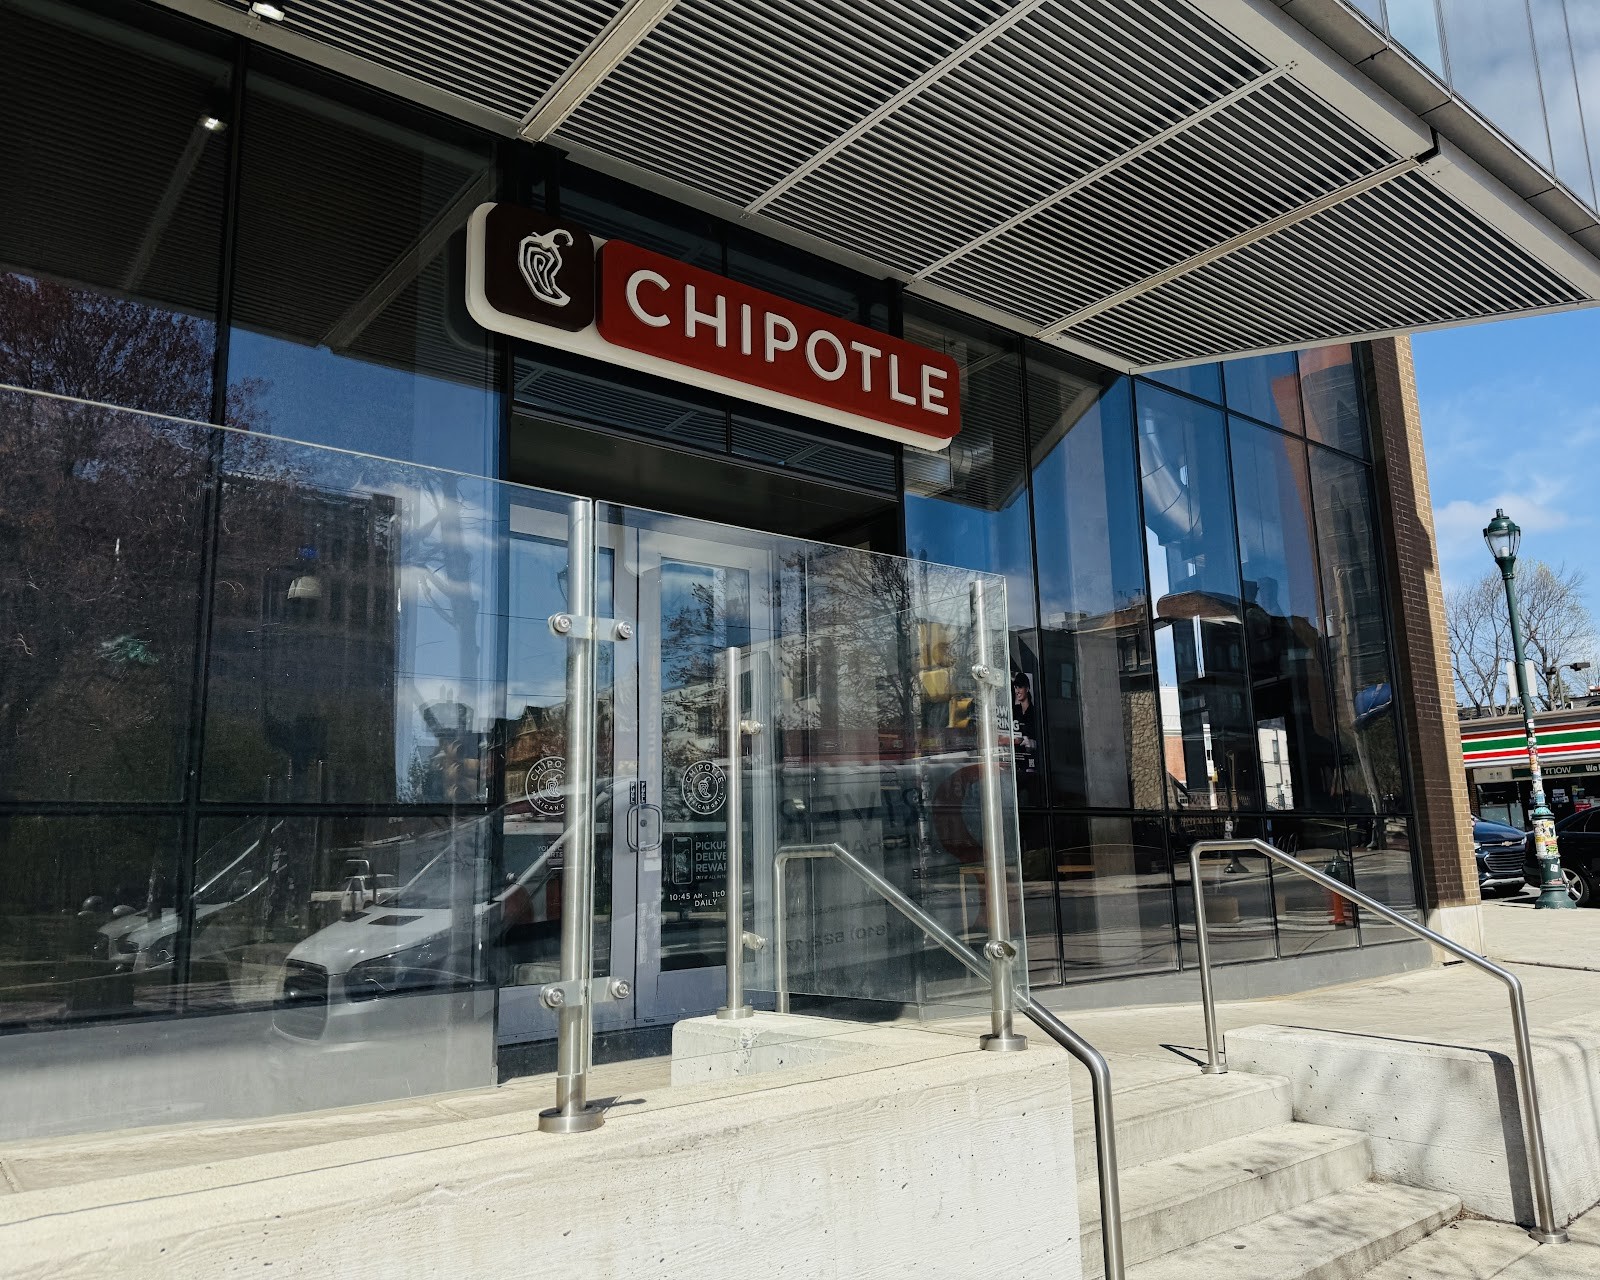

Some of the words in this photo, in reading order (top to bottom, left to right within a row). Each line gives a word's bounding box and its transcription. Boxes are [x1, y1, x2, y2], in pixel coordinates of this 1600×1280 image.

[625, 269, 949, 415] CHIPOTLE
[531, 760, 565, 780] CHIPO
[685, 764, 725, 783] CHIPOTLE
[695, 852, 727, 861] DELIVE
[695, 863, 727, 872] REWA
[669, 892, 691, 901] 10:45
[712, 890, 726, 898] 11:0
[694, 899, 718, 907] DAILY
